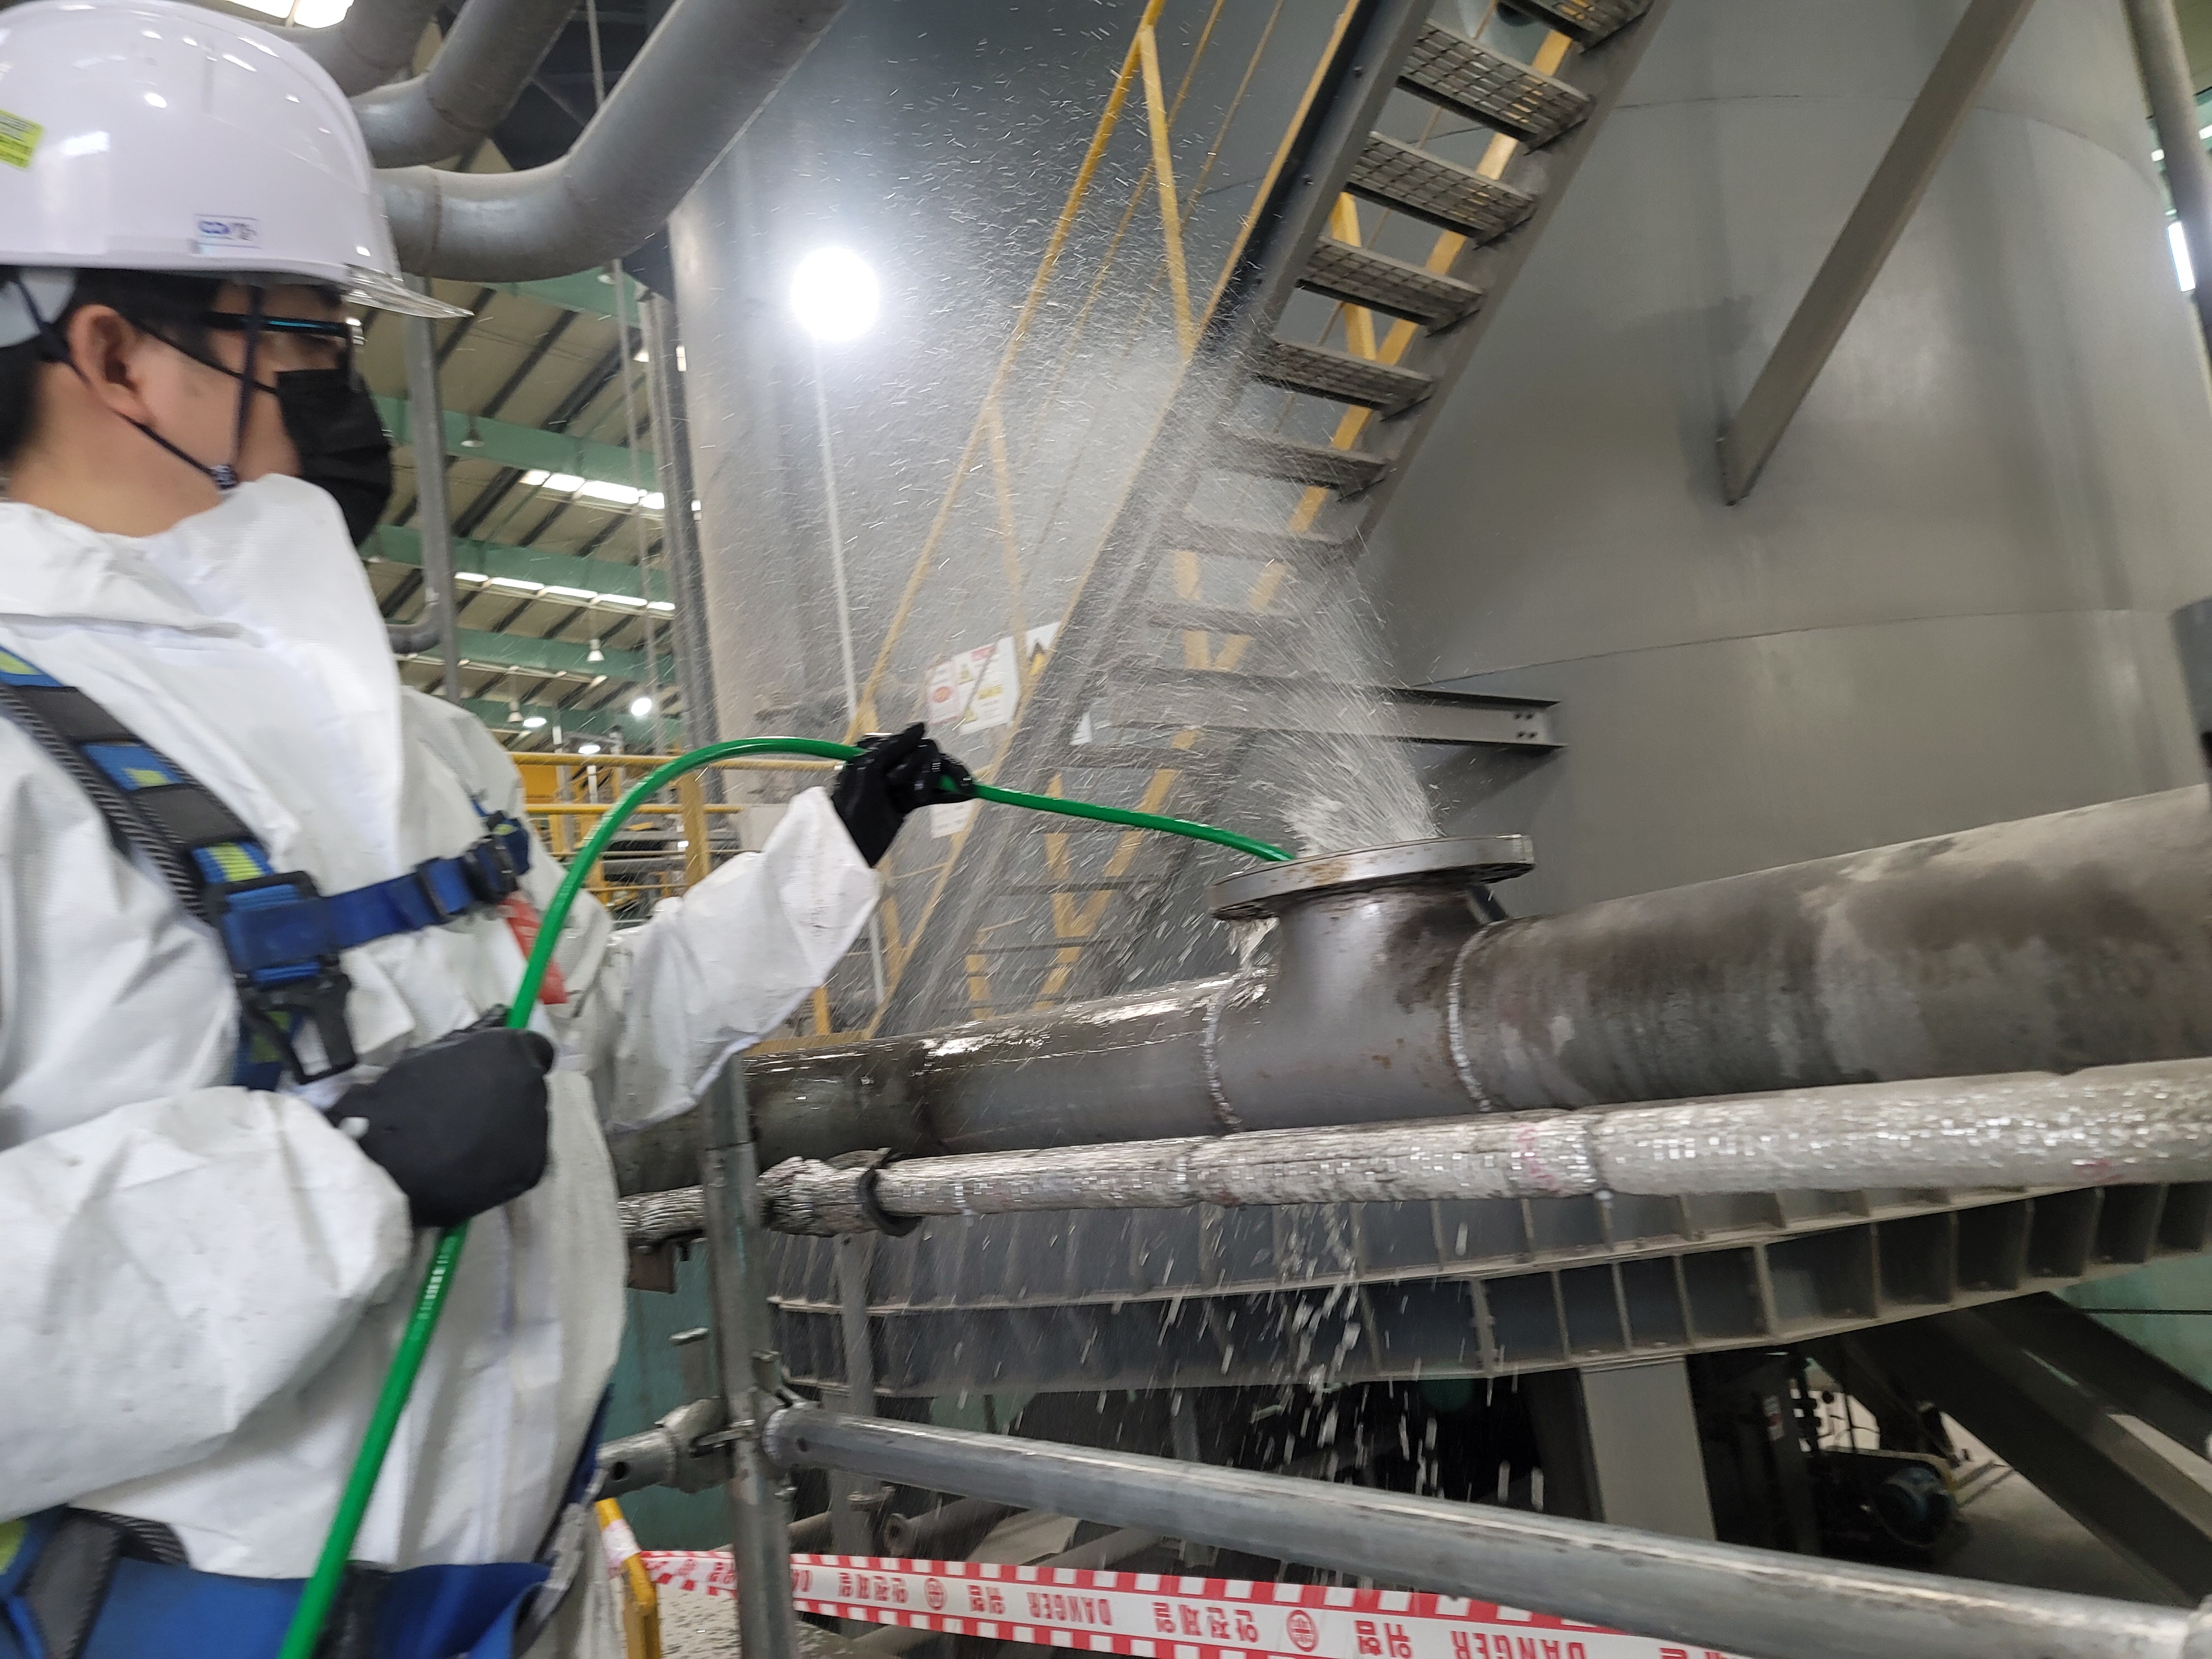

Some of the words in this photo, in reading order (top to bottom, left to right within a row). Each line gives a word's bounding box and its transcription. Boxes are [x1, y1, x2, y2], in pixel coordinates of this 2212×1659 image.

[837, 1572, 909, 1604] 안전제일
[967, 1585, 1006, 1615] 위험
[1026, 1592, 1113, 1626] DANGER
[1152, 1602, 1259, 1642] 안전제일
[1355, 1620, 1412, 1658] 위험
